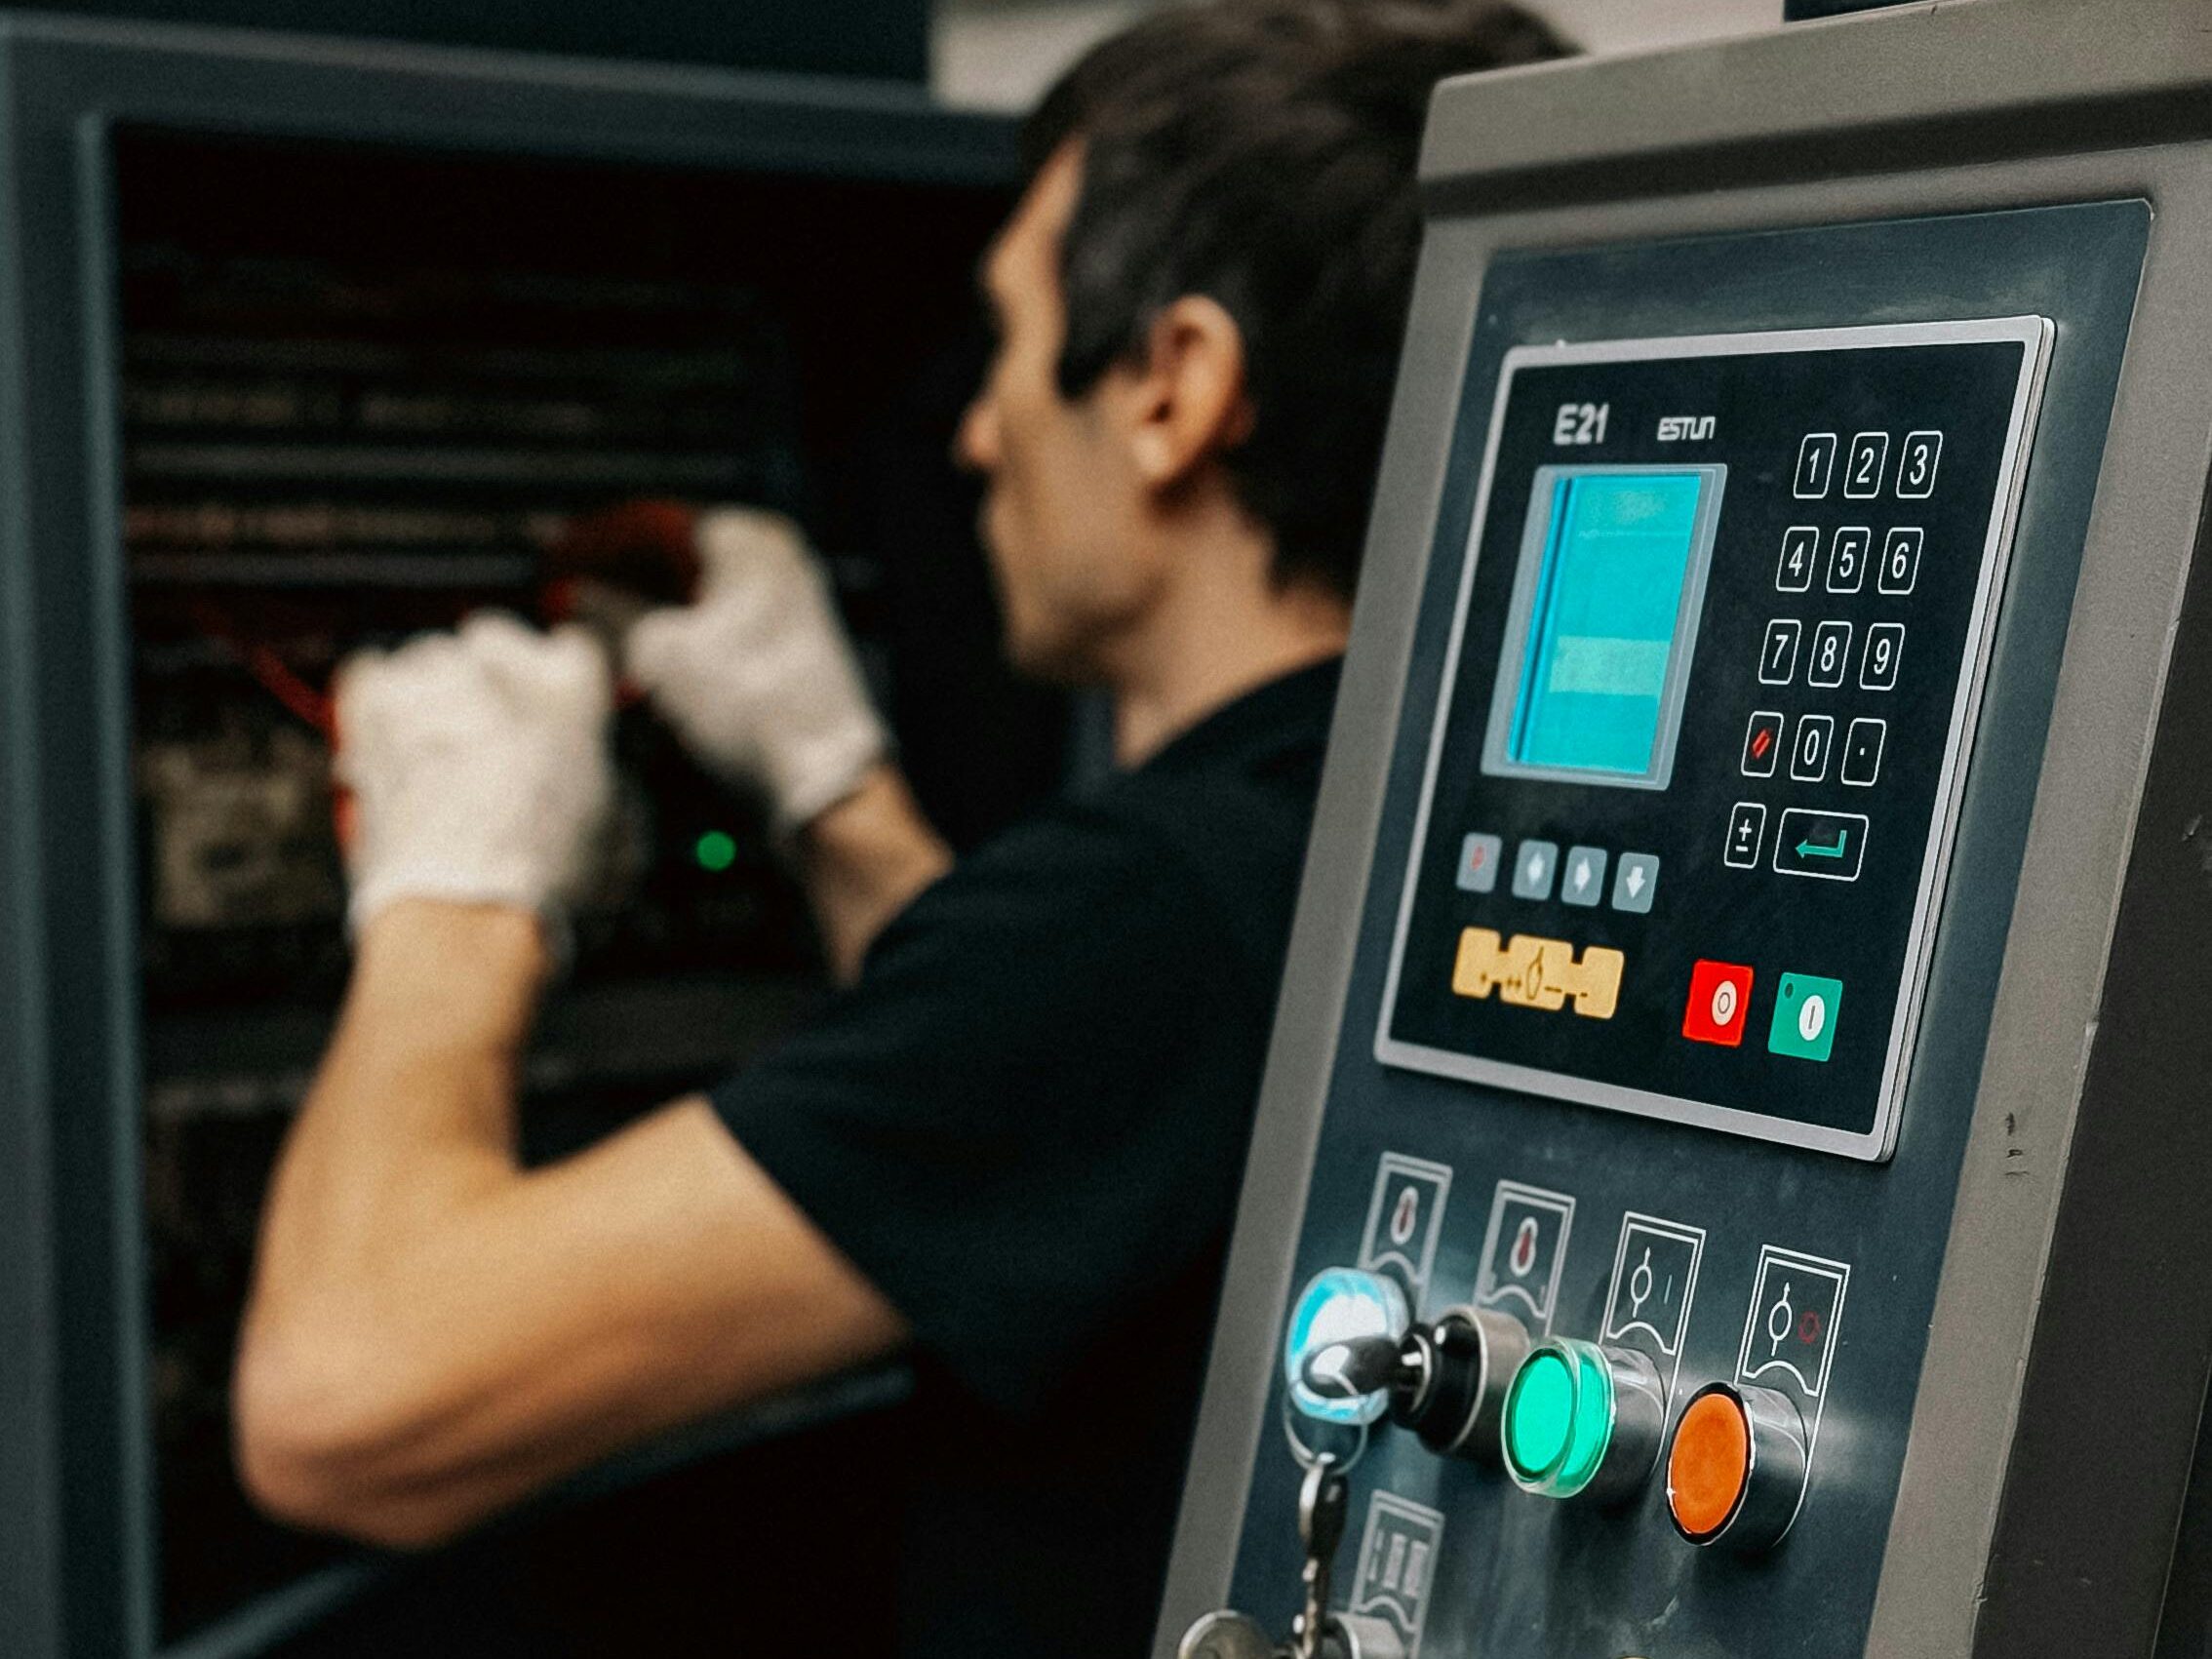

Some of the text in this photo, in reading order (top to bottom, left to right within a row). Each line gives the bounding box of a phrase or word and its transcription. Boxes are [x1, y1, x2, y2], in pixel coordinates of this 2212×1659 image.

[1554, 403, 1609, 446] E21
[1809, 444, 1928, 486] 1 2 3
[1788, 540, 1910, 579] 4 5 6
[1772, 634, 1891, 675] 7 8 9
[1803, 729, 1820, 766] 0
